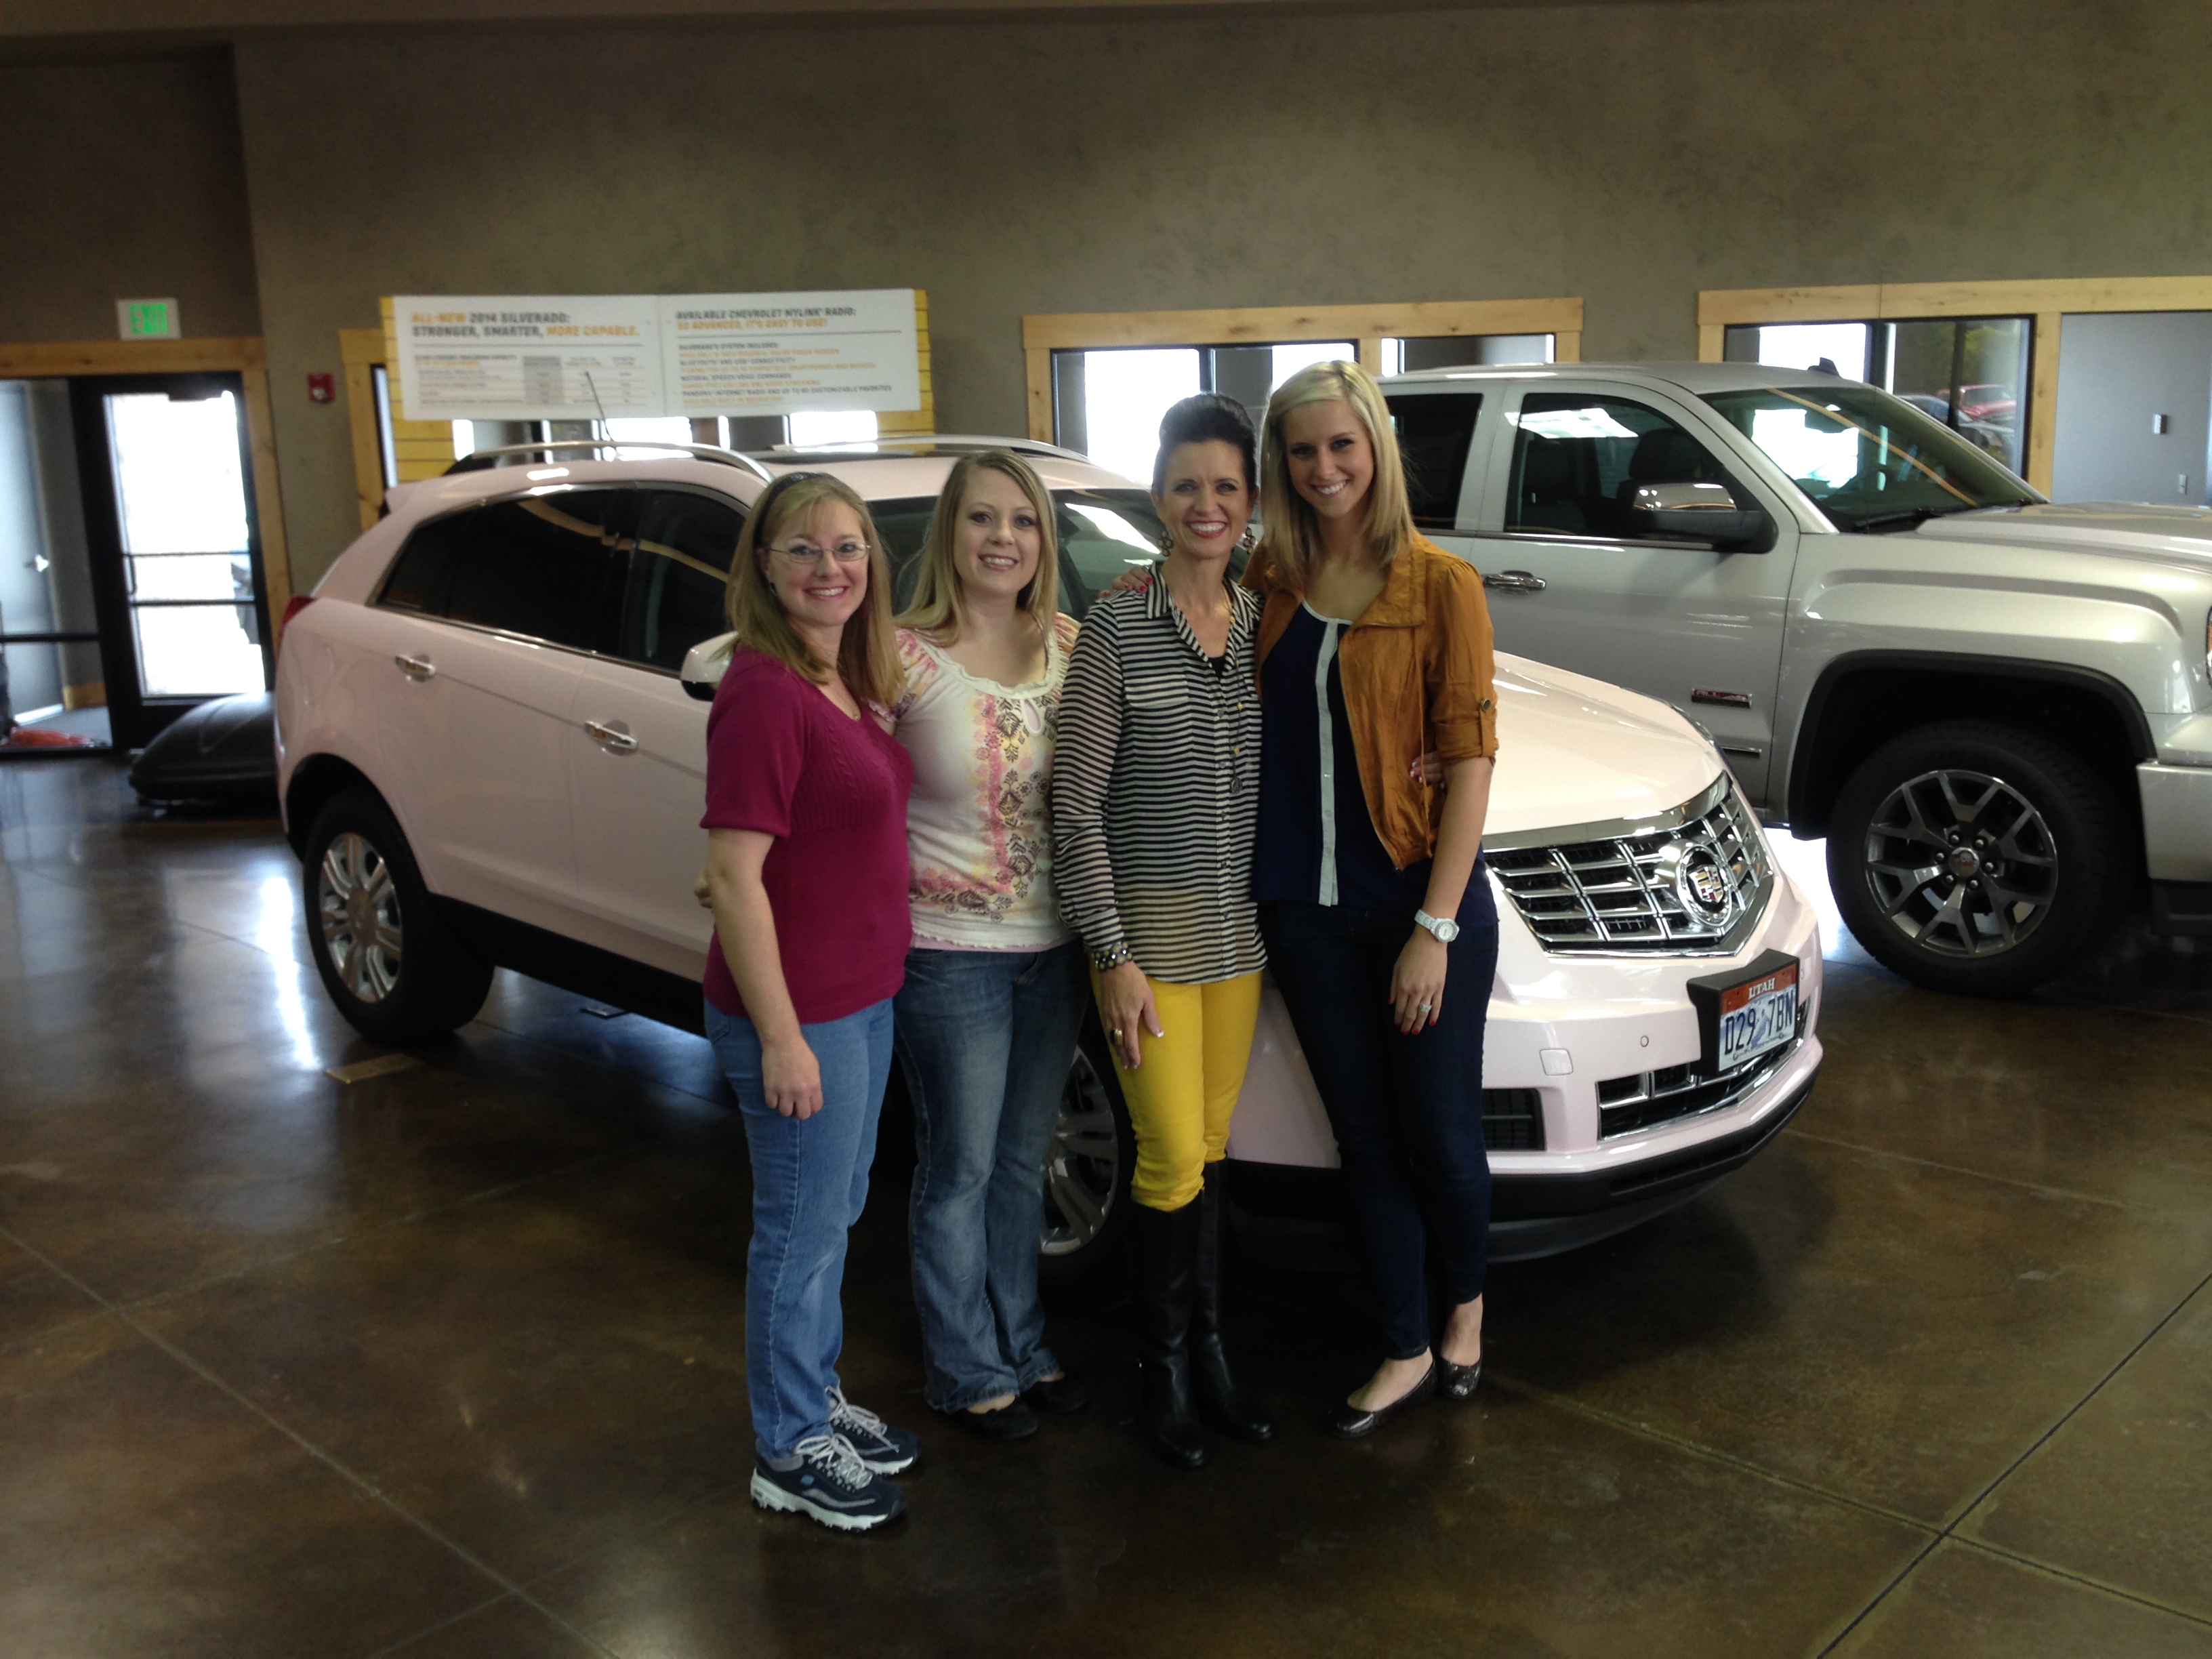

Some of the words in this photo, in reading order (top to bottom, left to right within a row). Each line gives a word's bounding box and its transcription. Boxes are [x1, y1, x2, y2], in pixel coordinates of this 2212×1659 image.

[129, 302, 168, 335] EXIT
[469, 312, 497, 323] 2014
[676, 310, 726, 319] AVAILABLE
[729, 308, 781, 319] CHEVROLET
[1748, 978, 1775, 999] UTAH
[1768, 989, 1793, 1036] 7BN
